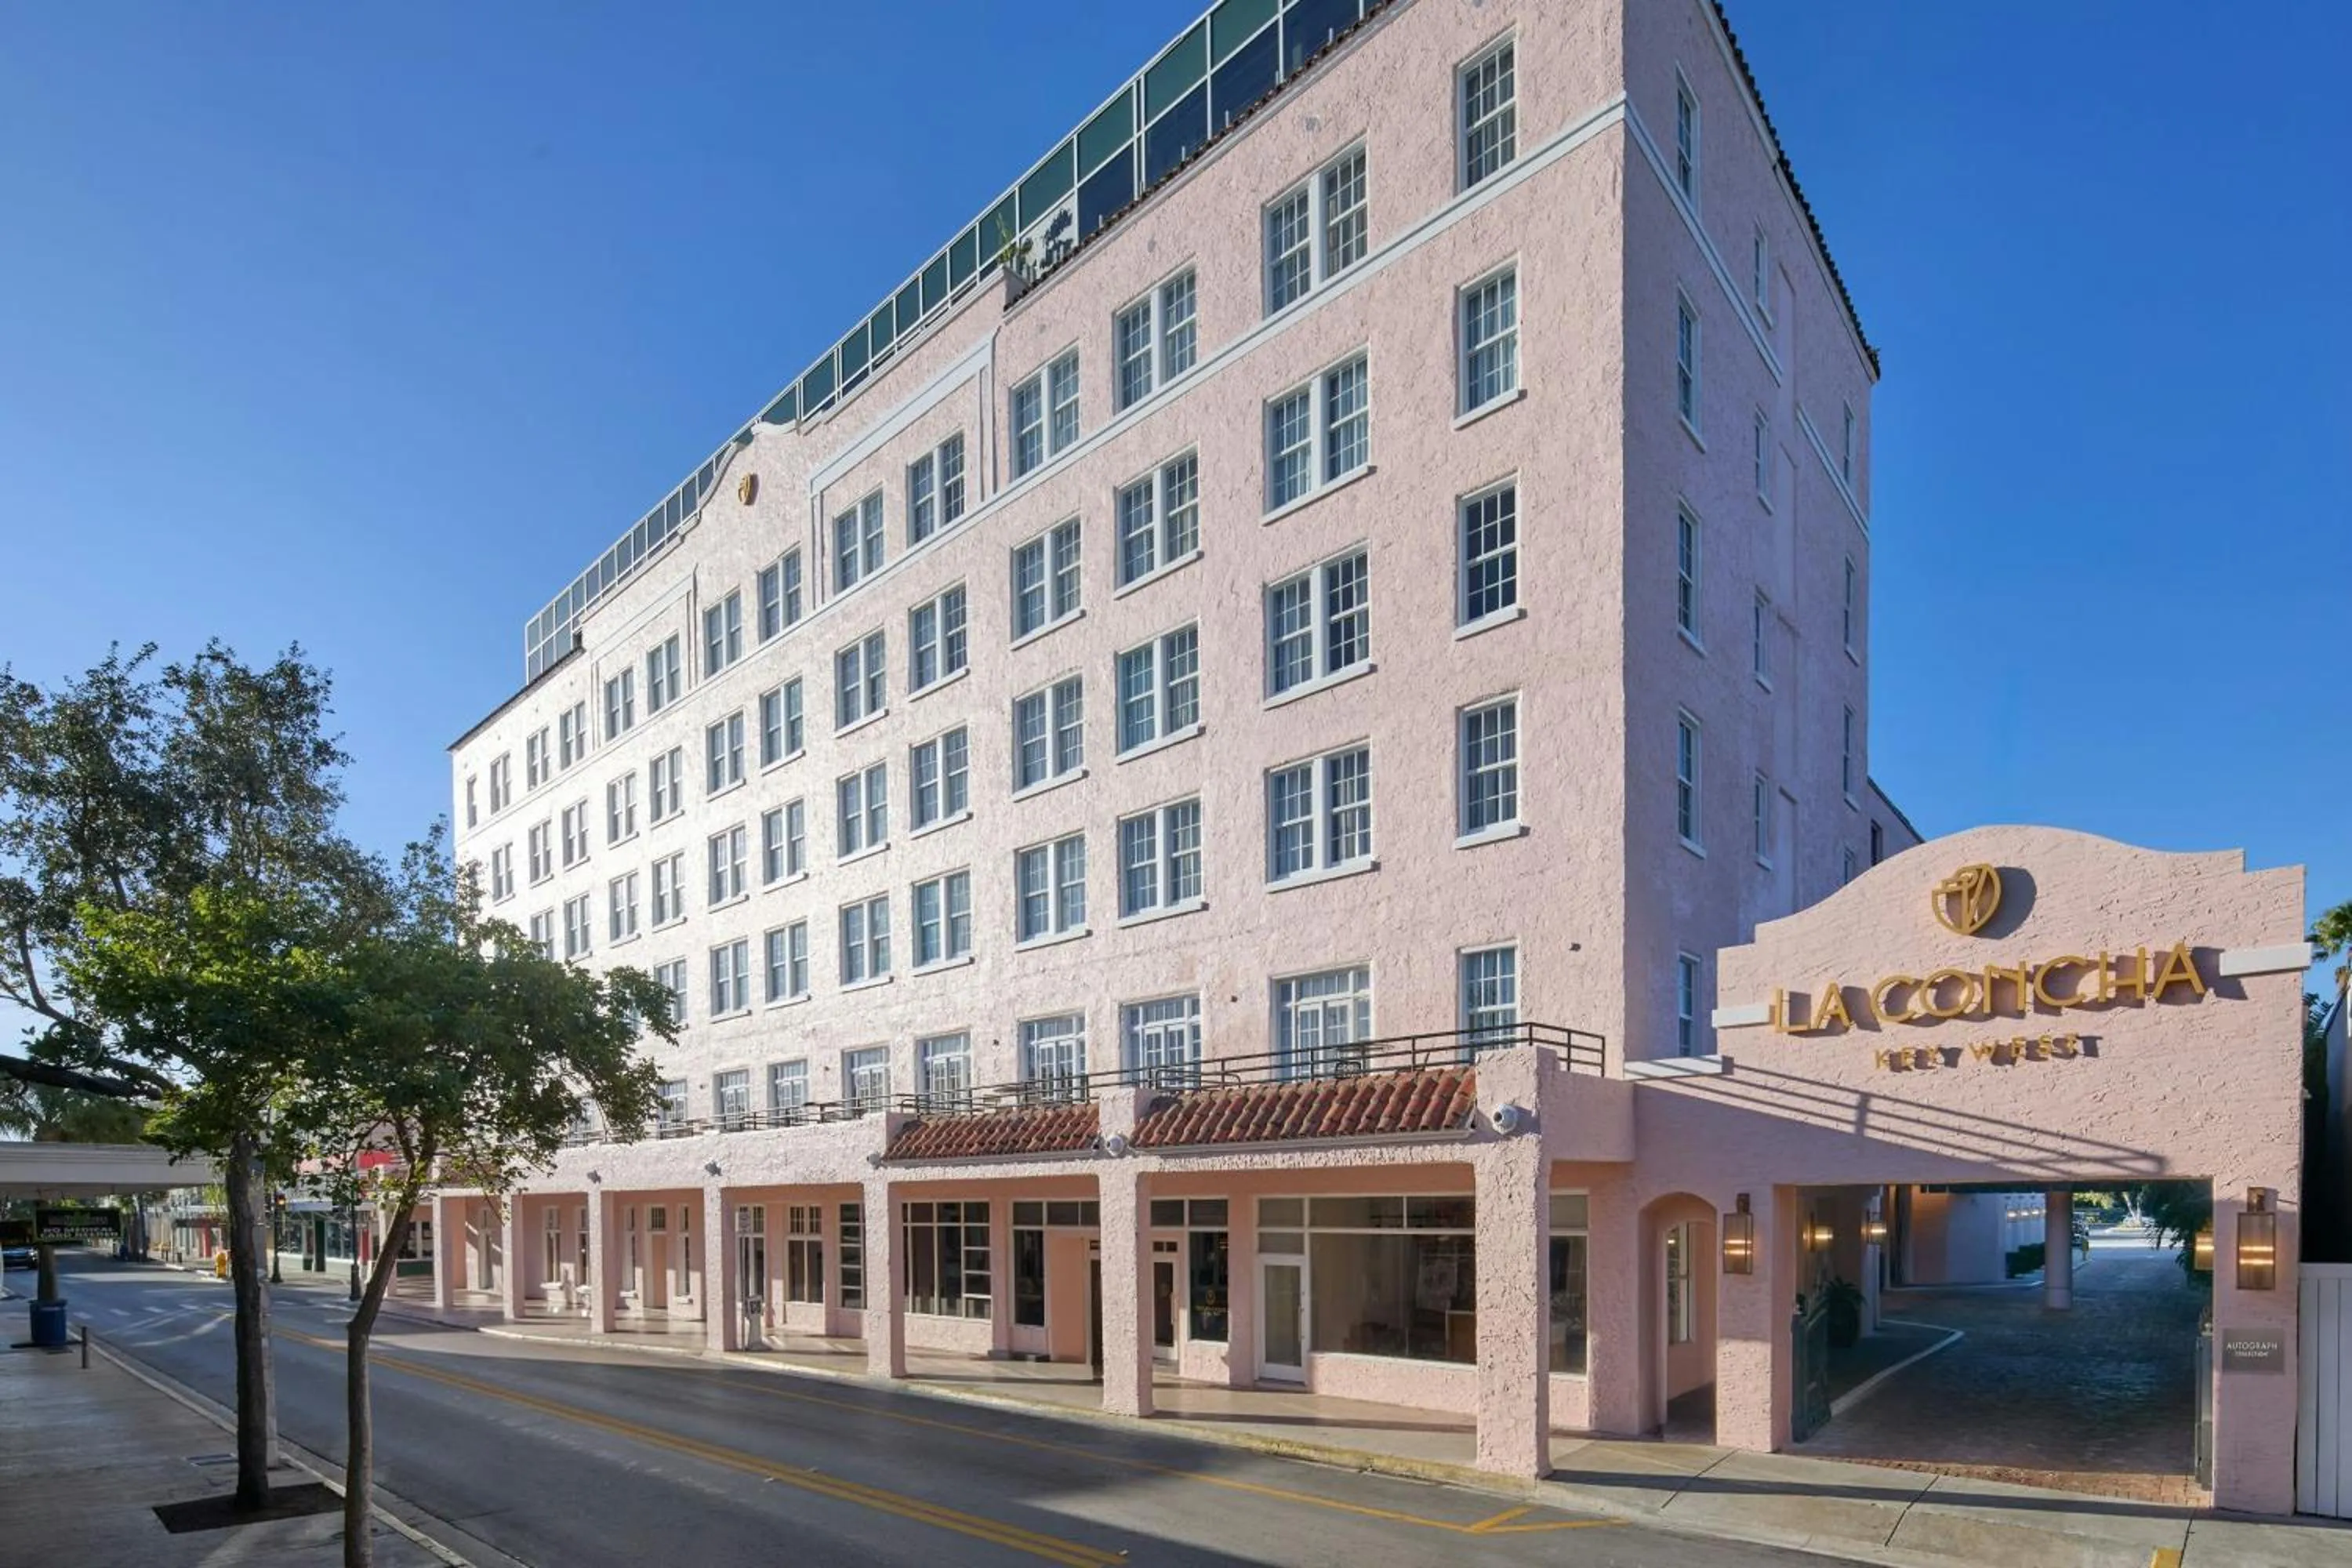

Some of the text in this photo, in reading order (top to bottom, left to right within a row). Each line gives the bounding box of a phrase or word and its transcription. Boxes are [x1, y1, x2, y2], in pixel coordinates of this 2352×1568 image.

[1769, 942, 2206, 1033] LA CONCHA
[1875, 1033, 2079, 1069] KEY WEST
[2227, 1341, 2278, 1350] AUTOGRAPH
